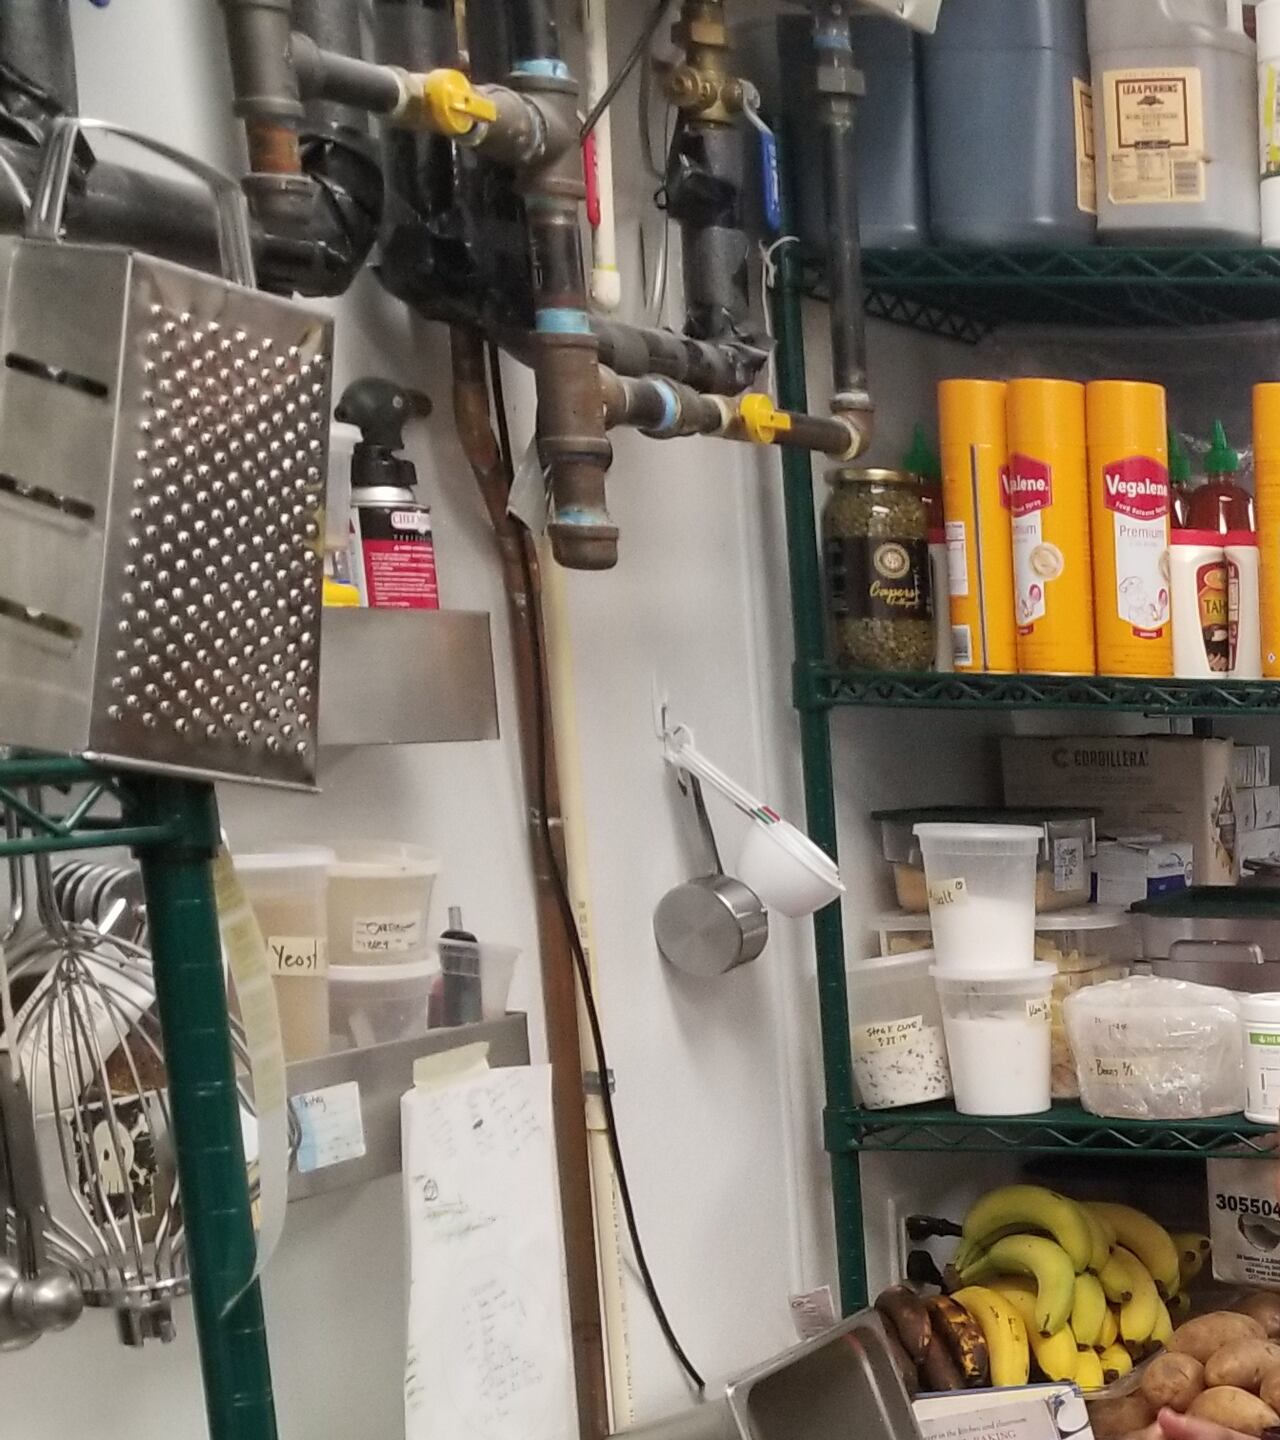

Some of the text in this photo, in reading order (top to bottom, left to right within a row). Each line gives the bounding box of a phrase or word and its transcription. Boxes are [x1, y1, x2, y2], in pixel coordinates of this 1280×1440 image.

[1119, 524, 1164, 539] Premium
[1204, 599, 1227, 615] TAH
[272, 940, 317, 970] Yeast
